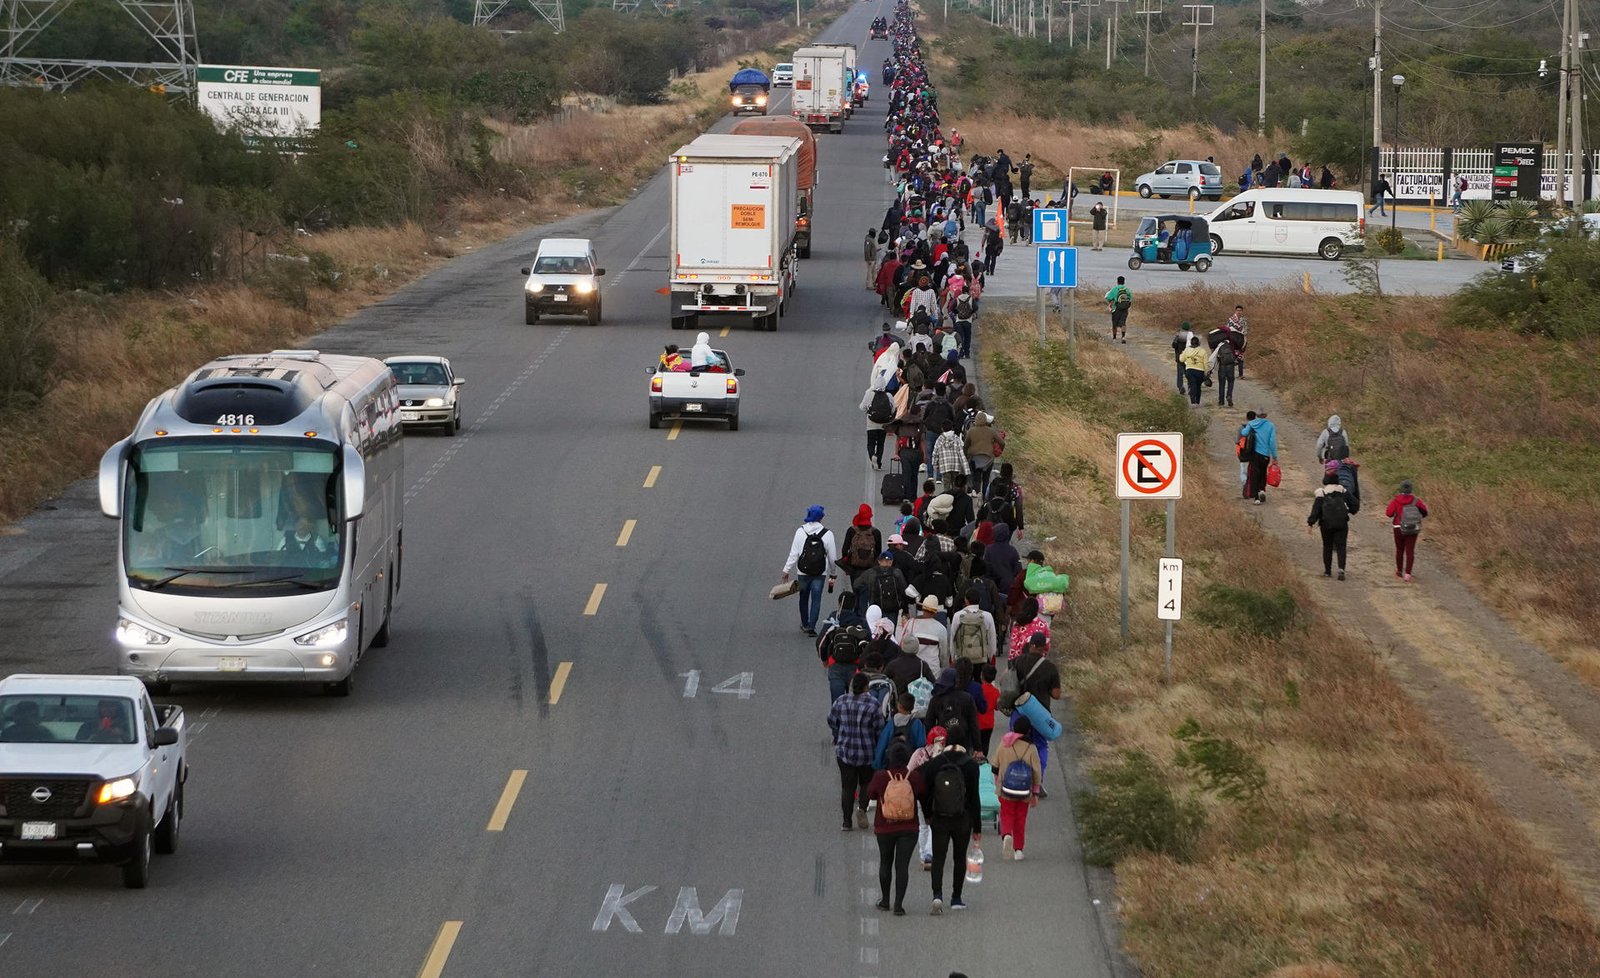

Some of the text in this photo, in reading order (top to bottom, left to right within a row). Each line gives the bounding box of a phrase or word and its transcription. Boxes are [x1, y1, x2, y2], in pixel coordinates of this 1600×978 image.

[224, 70, 249, 82] CFE
[207, 91, 309, 103] CENTRAL DE GENERACION
[231, 105, 289, 116] CE OAXACA III
[1396, 174, 1443, 185] FACTURACION
[1400, 186, 1414, 195] LAS
[1416, 186, 1428, 195] 24
[216, 413, 255, 426] 4816
[1162, 562, 1179, 571] km
[1167, 578, 1173, 591] 1
[1163, 599, 1176, 612] 4
[591, 882, 744, 936] KM
